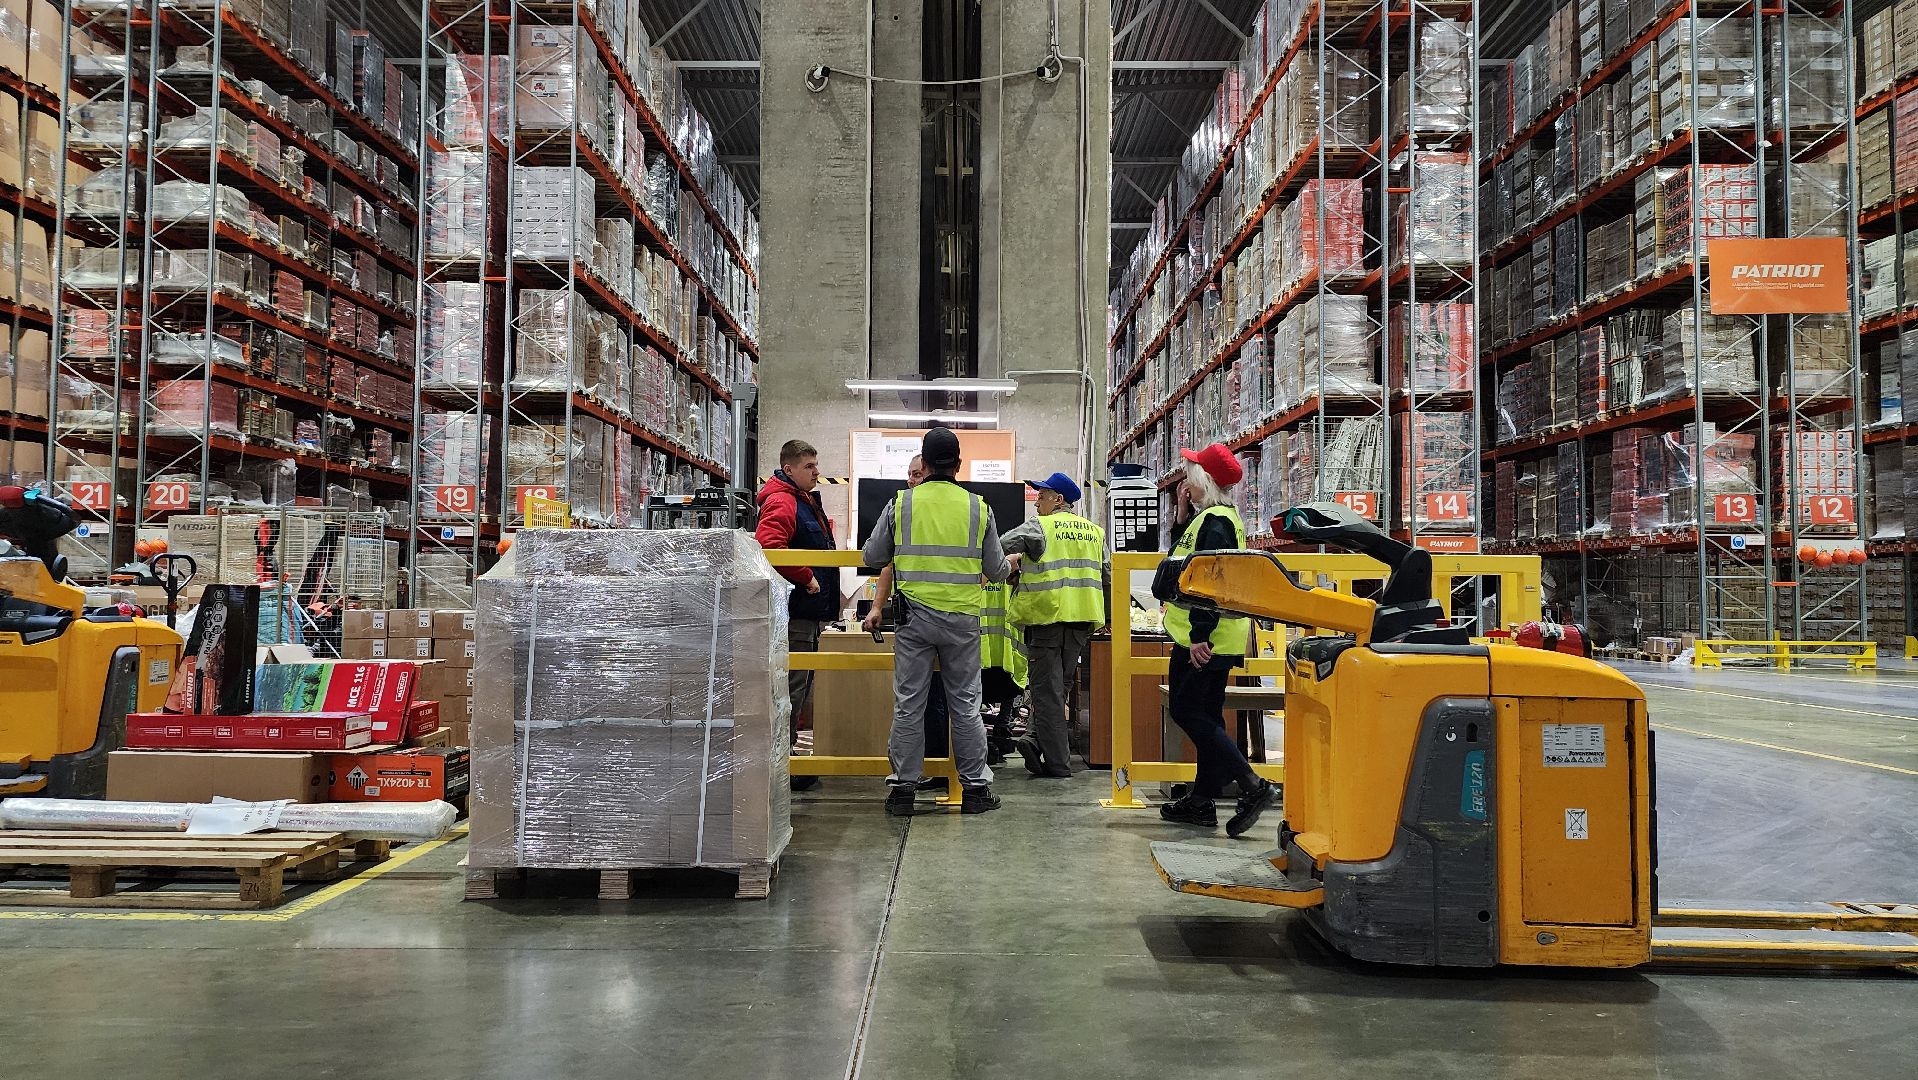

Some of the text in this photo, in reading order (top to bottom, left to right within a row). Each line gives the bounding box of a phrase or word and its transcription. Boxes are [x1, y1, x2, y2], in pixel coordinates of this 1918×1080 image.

[1731, 264, 1825, 279] PATRIOT
[80, 484, 103, 505] 21
[154, 484, 185, 505] 20
[443, 487, 468, 507] 19
[1343, 494, 1368, 515] 15
[1435, 494, 1460, 515] 14
[1722, 496, 1748, 517] 13
[1817, 497, 1845, 518] 12
[1055, 531, 1099, 544] КЛАДВЩИК
[1429, 540, 1465, 548] PATRIOT
[186, 671, 194, 709] PATRIOT
[346, 686, 361, 708] MCE
[354, 665, 366, 684] 116
[377, 777, 432, 788] TR 4024XL
[1471, 762, 1483, 787] 120
[244, 882, 260, 898] 74
